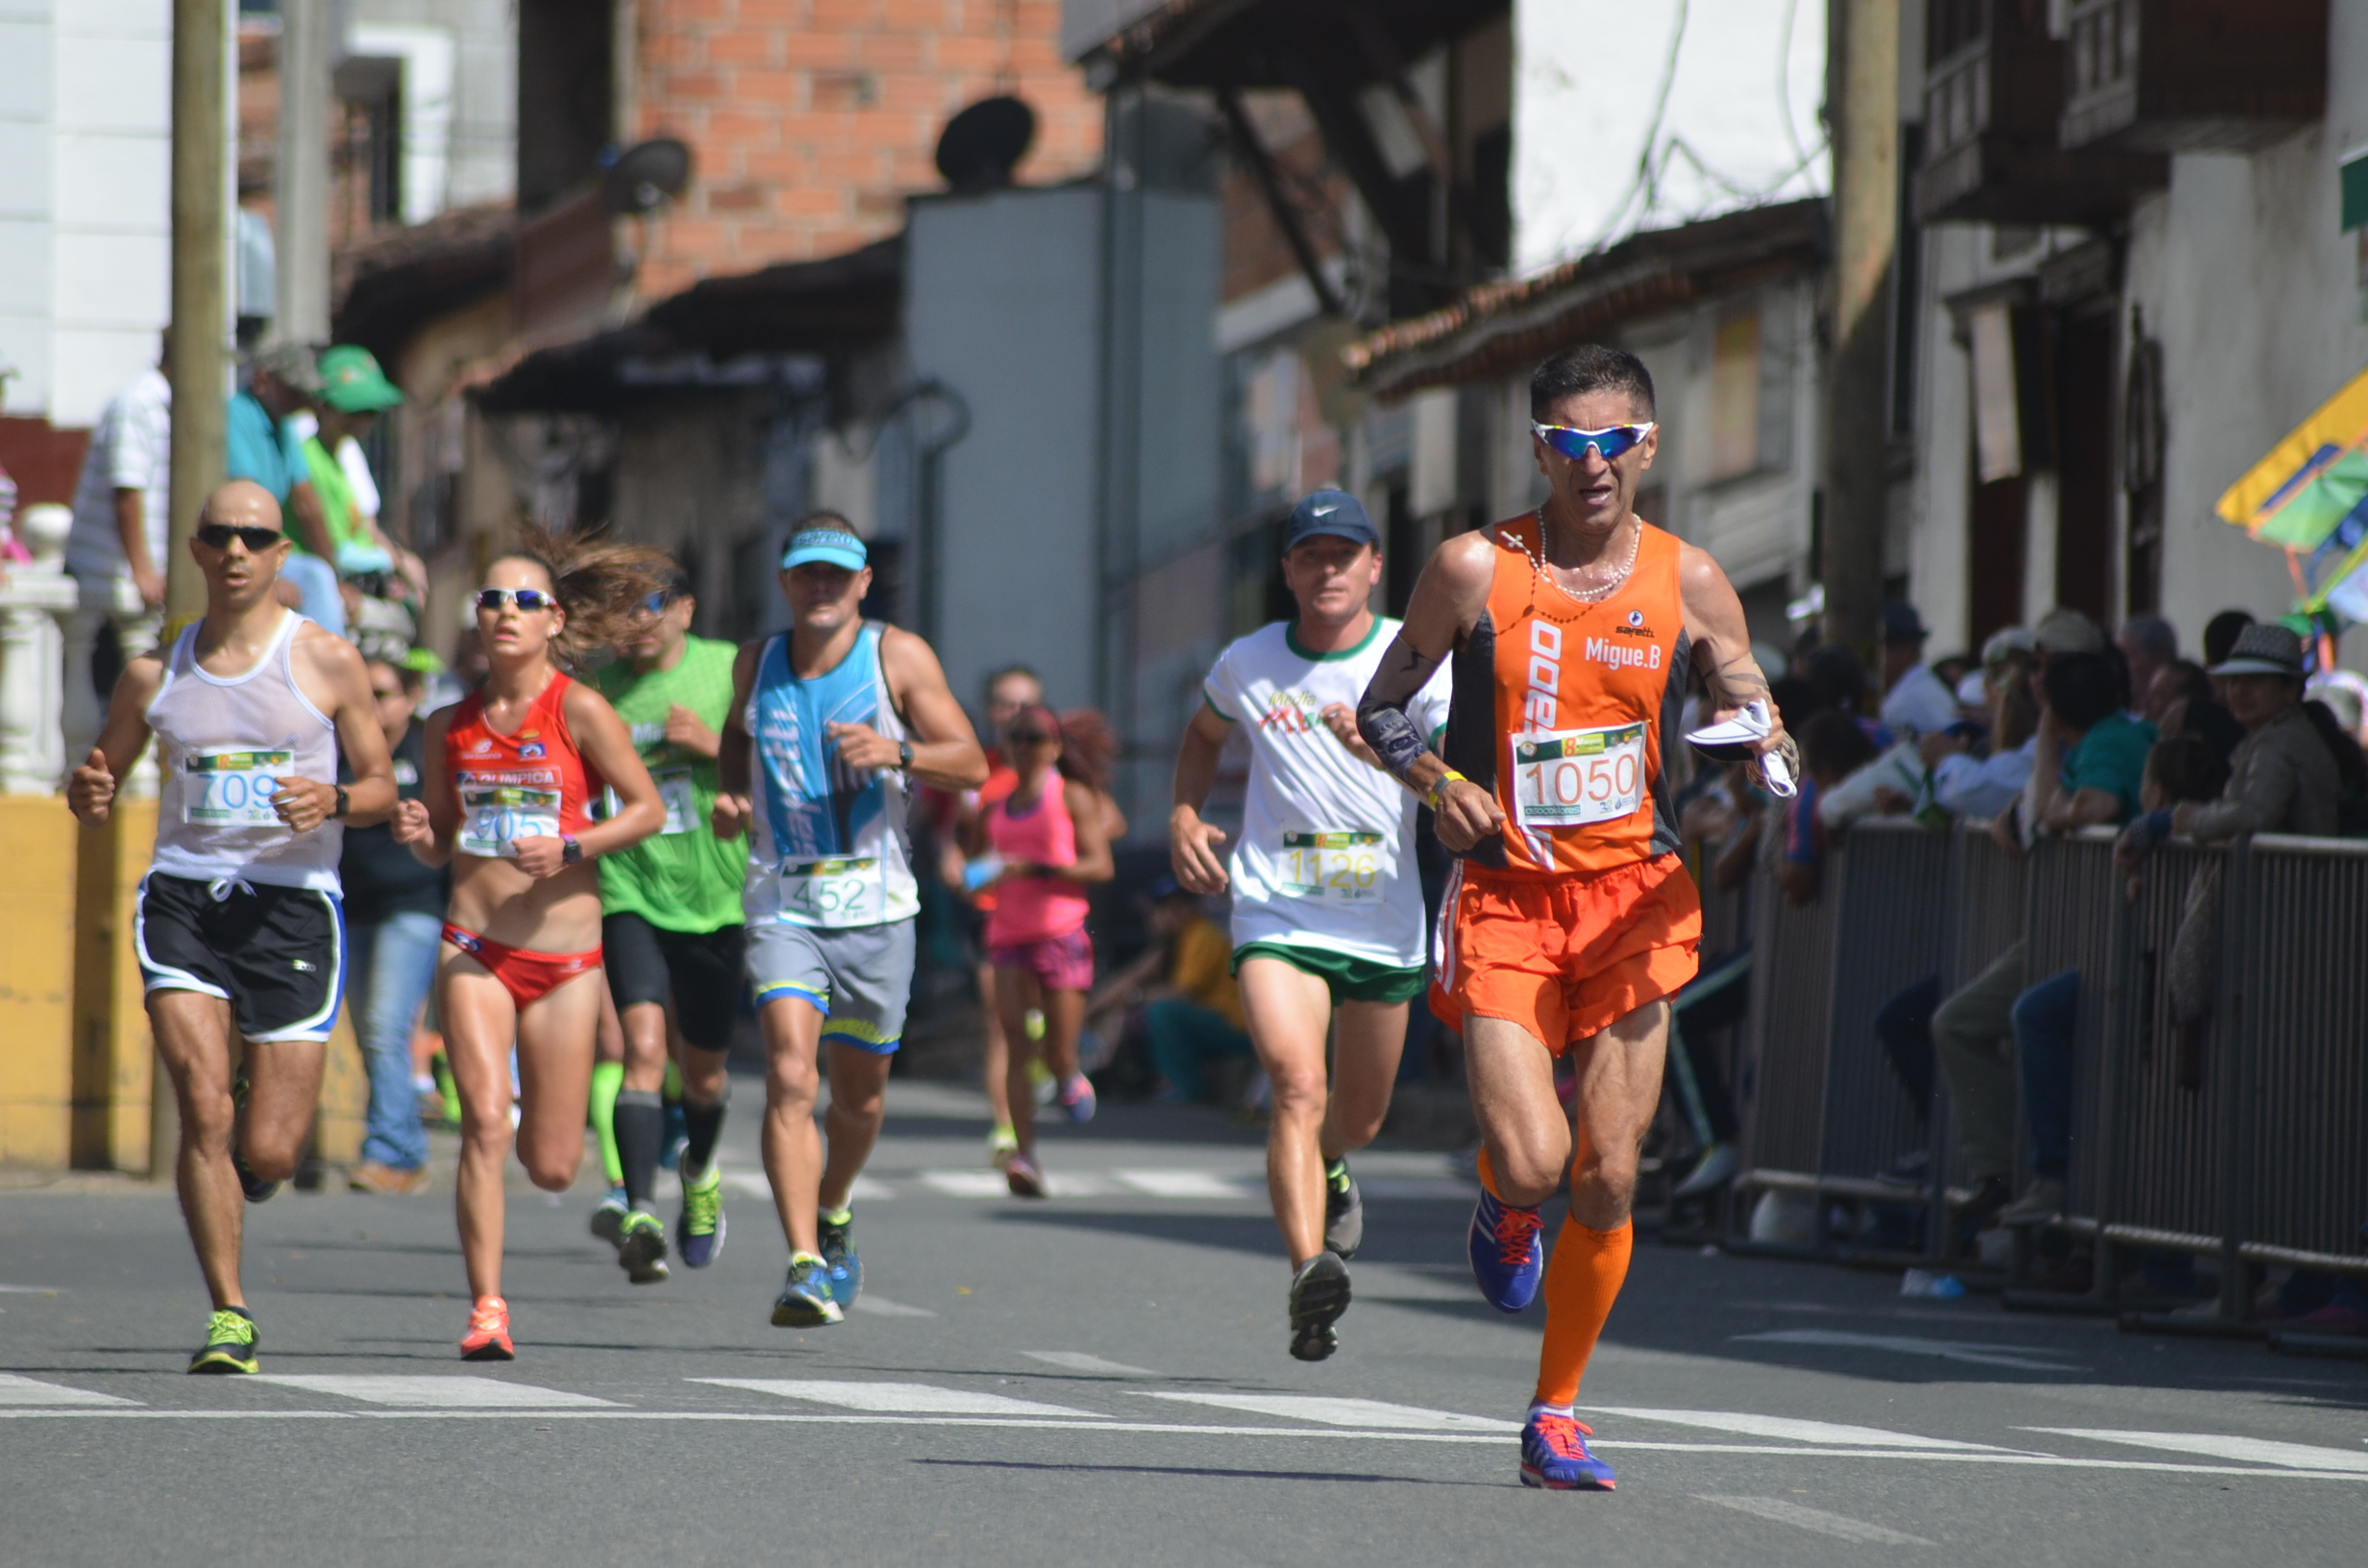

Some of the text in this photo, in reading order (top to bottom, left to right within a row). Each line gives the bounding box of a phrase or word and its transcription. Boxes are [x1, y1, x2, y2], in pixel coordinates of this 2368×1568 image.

[1586, 636, 1662, 671] Migue.B
[1269, 691, 1318, 707] Media
[198, 773, 279, 809] 709
[1526, 753, 1639, 805] 1050
[476, 808, 543, 843] 905
[1290, 848, 1375, 888] 1126
[793, 878, 865, 912] 452
